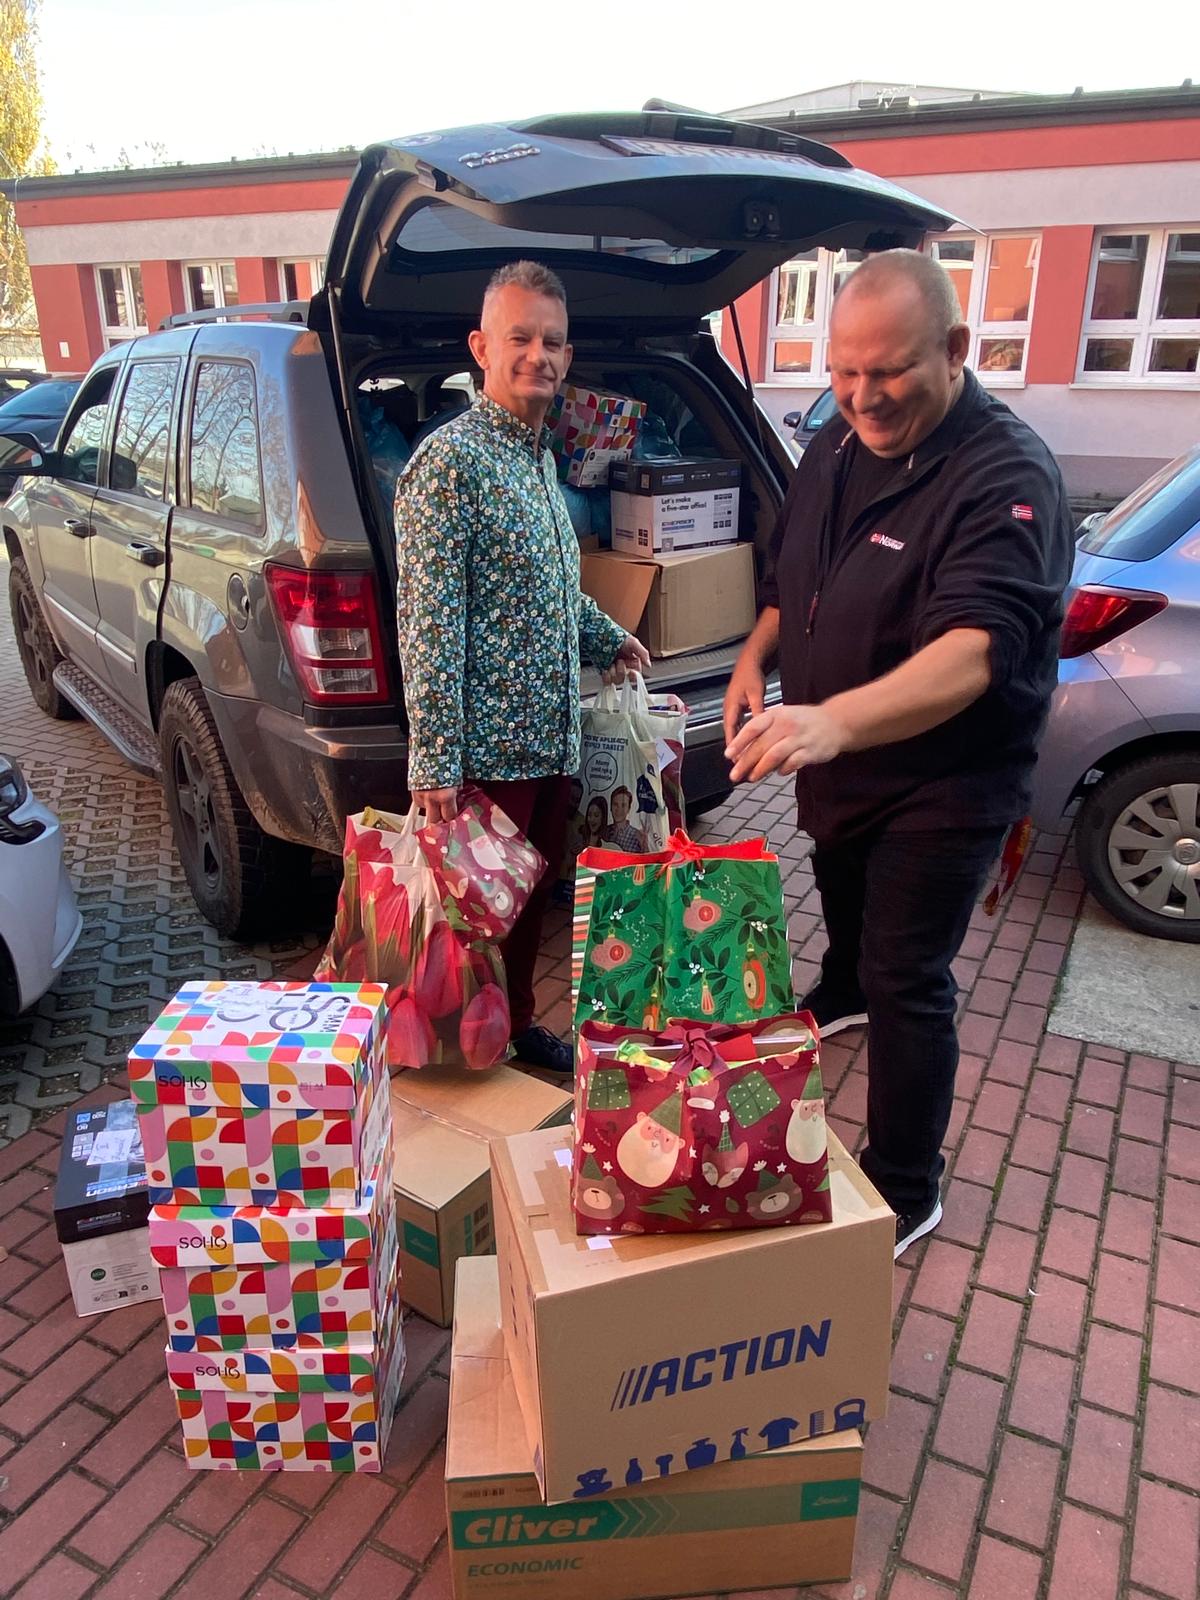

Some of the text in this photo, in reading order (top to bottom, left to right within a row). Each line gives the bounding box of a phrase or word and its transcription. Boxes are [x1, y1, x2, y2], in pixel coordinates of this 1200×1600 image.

[641, 1319, 832, 1403] ACTION
[464, 1513, 598, 1544] Cliver
[467, 1556, 584, 1577] ECONOMIC
